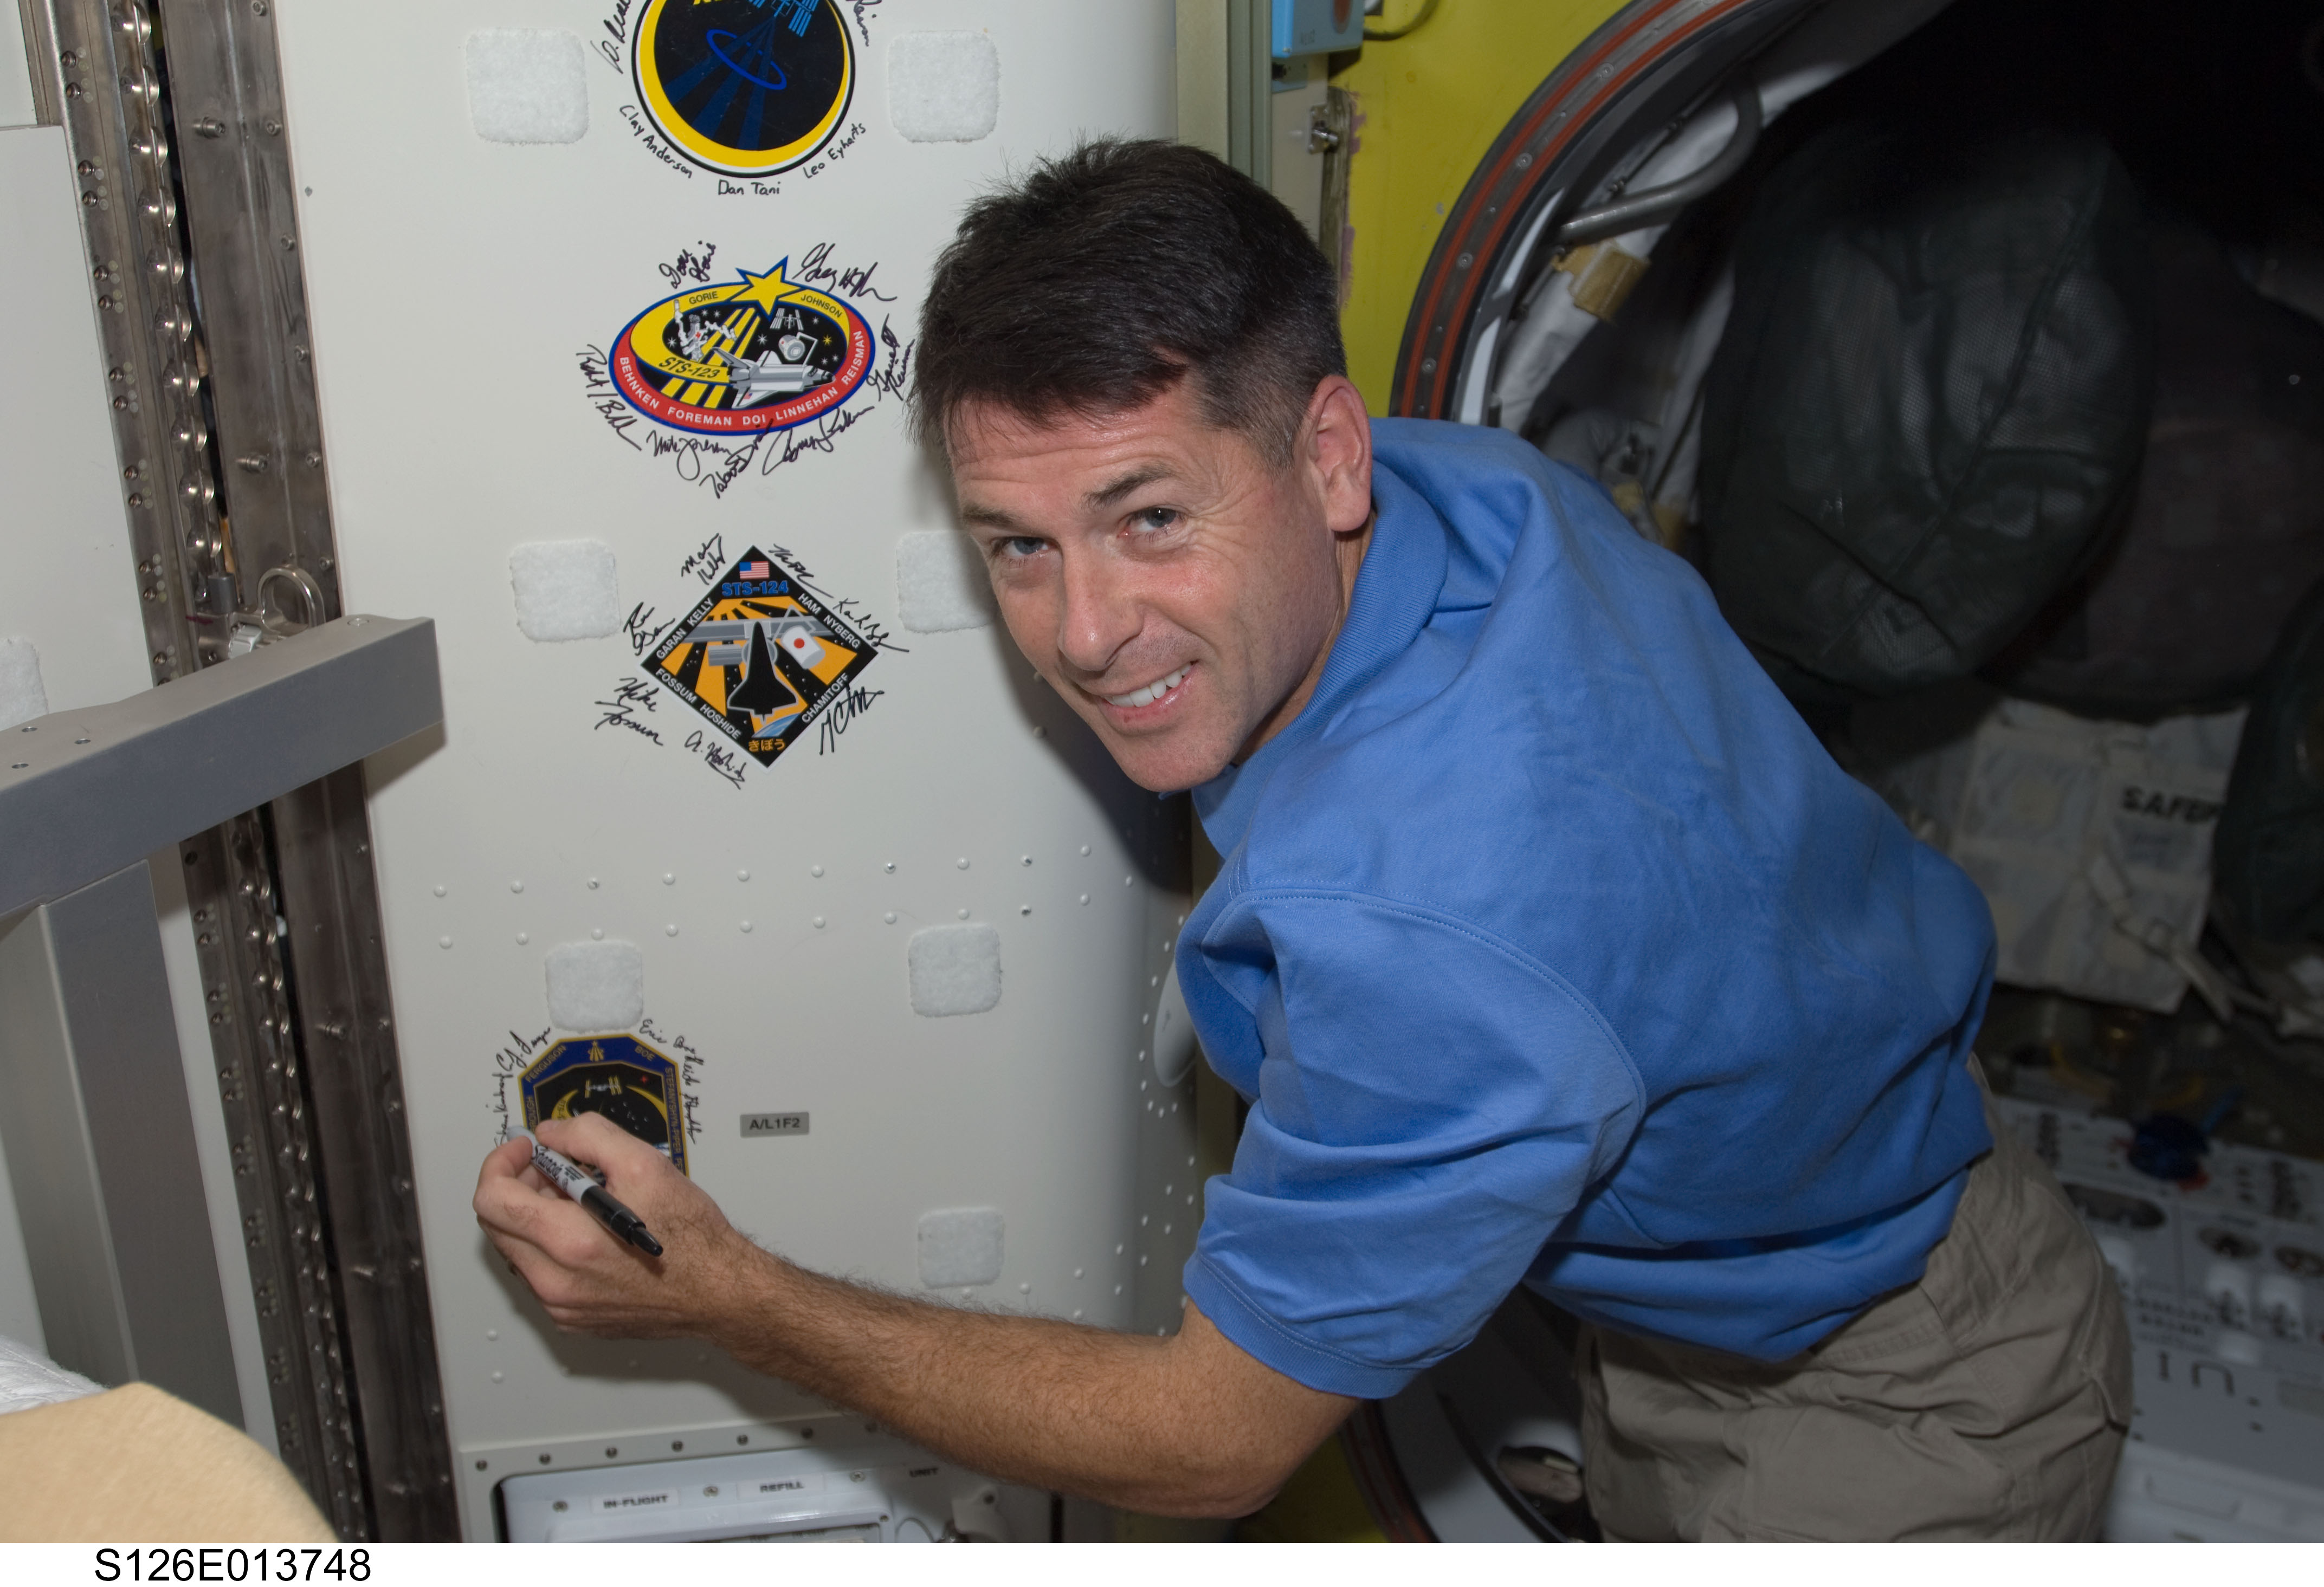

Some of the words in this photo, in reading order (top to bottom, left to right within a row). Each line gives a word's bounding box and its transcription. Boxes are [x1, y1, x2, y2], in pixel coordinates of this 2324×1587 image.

[619, 105, 644, 136] Clay
[642, 134, 693, 179] Anderson
[803, 163, 825, 179] Leo
[828, 123, 866, 160] Eyharts
[718, 179, 744, 195] Dan
[751, 181, 781, 195] Tani
[689, 291, 719, 305] GORIE
[801, 294, 842, 318] JOHNSON
[619, 357, 660, 410] BEHNKEN
[667, 406, 732, 426] FOREMAN
[742, 414, 766, 426] DOI
[776, 387, 838, 420] LINNEHAN
[841, 331, 864, 386] REISMAN
[659, 357, 720, 379] STS-123
[721, 580, 789, 596] STS-124
[656, 627, 687, 659] GARAN
[687, 597, 715, 627] KELLY
[798, 593, 822, 615] HAM
[823, 614, 861, 650] NYBERG
[655, 668, 698, 704] FOSSUM
[700, 703, 742, 740] HOSHIDE
[802, 672, 849, 724] CHAMITOFF
[747, 738, 785, 752] きぼう
[524, 1044, 567, 1083] FERGUSON
[634, 1045, 655, 1061] BOE
[749, 1118, 801, 1130] A/L1F2
[603, 1495, 669, 1510] IN-FLIGHT
[760, 1481, 805, 1494] REFILL
[909, 1467, 939, 1478] UNIT
